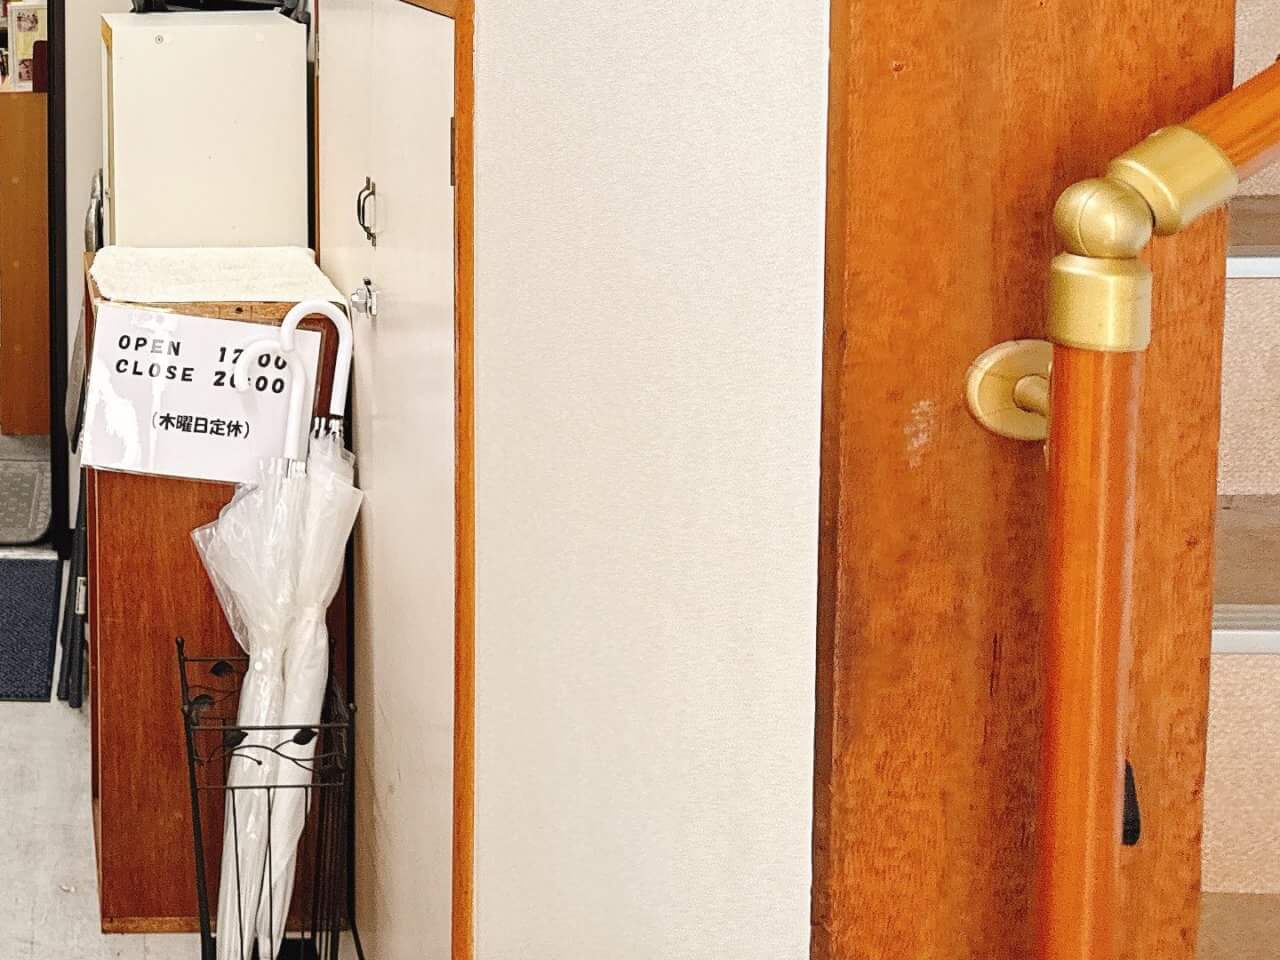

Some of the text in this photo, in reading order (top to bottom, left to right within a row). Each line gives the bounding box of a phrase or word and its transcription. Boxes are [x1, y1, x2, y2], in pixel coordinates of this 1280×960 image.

[118, 334, 287, 370] OPEN 1700
[115, 358, 195, 382] CLOSE
